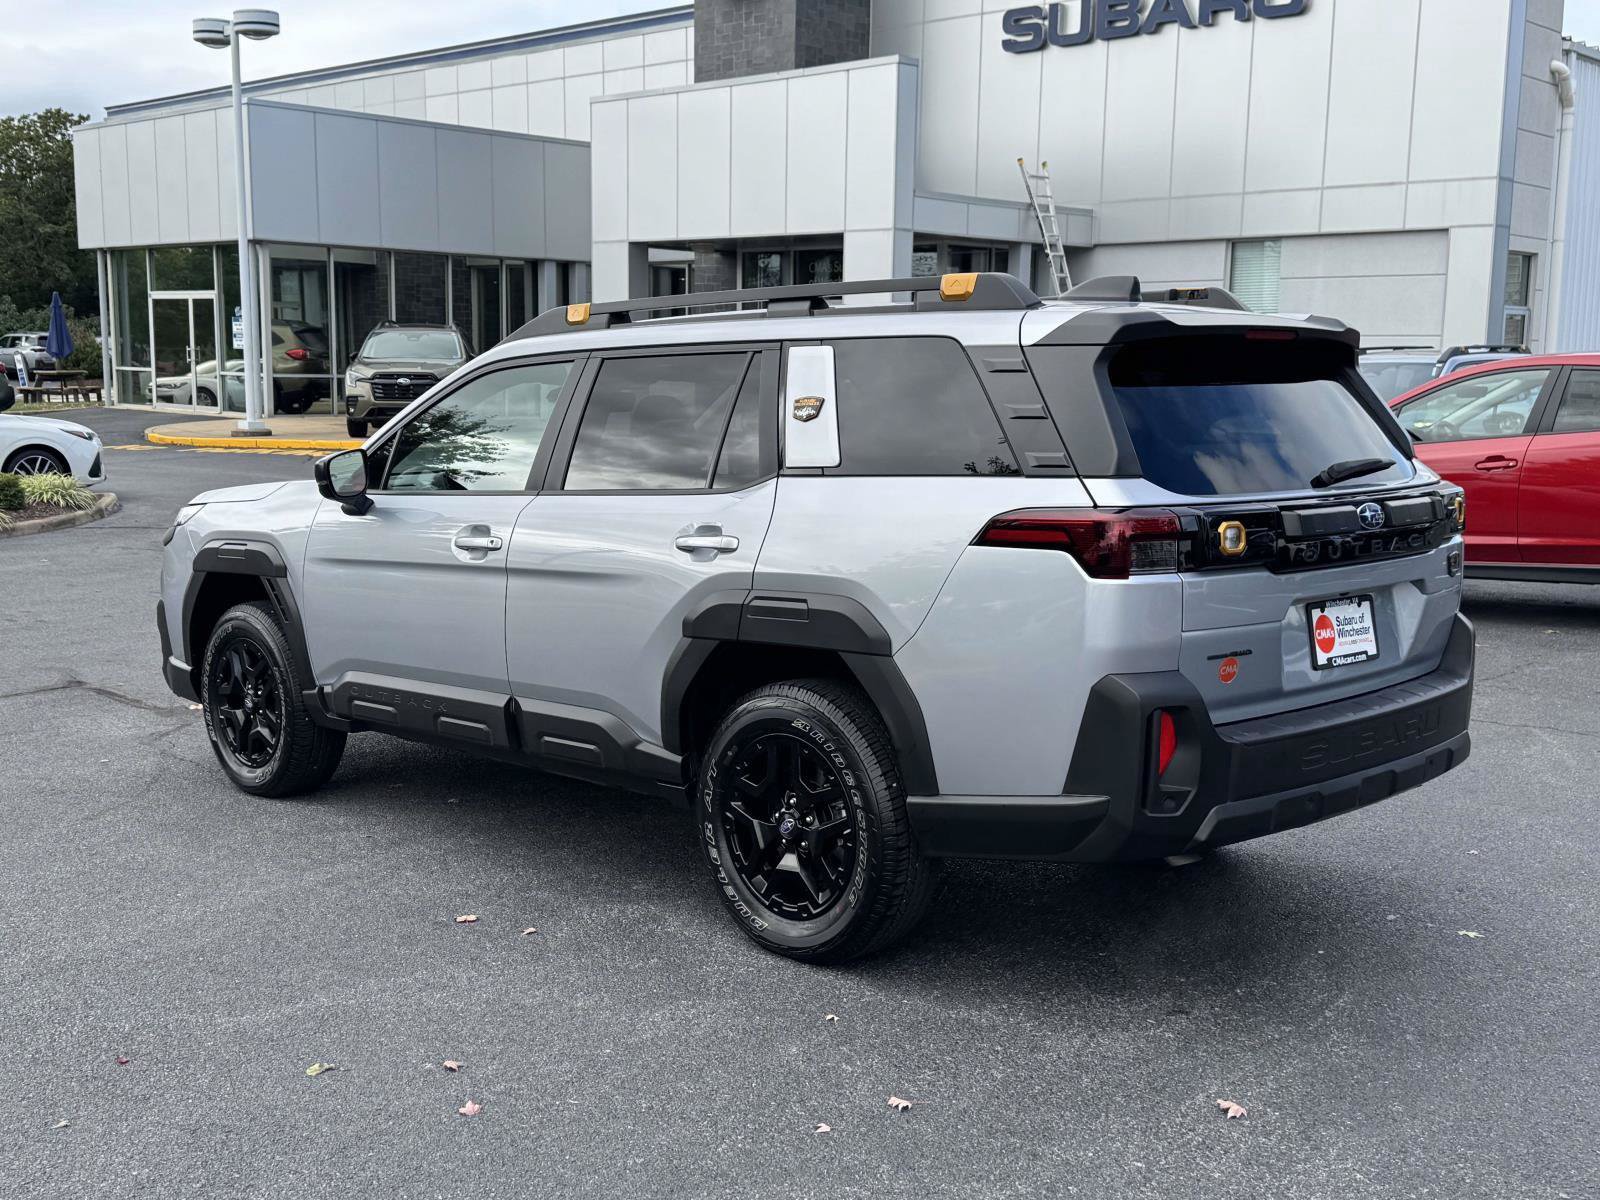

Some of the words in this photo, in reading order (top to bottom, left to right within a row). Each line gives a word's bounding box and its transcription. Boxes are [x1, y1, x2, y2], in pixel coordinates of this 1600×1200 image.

[1301, 532, 1434, 562] OUTBACK
[1336, 616, 1357, 627] Subaru
[1358, 613, 1365, 624] of
[1337, 626, 1370, 639] Winchester
[1332, 654, 1367, 667] CMAcars.com
[349, 685, 450, 712] OUTBACK
[1302, 706, 1441, 770] SUBARU
[791, 718, 868, 909] BRIDGESTONE
